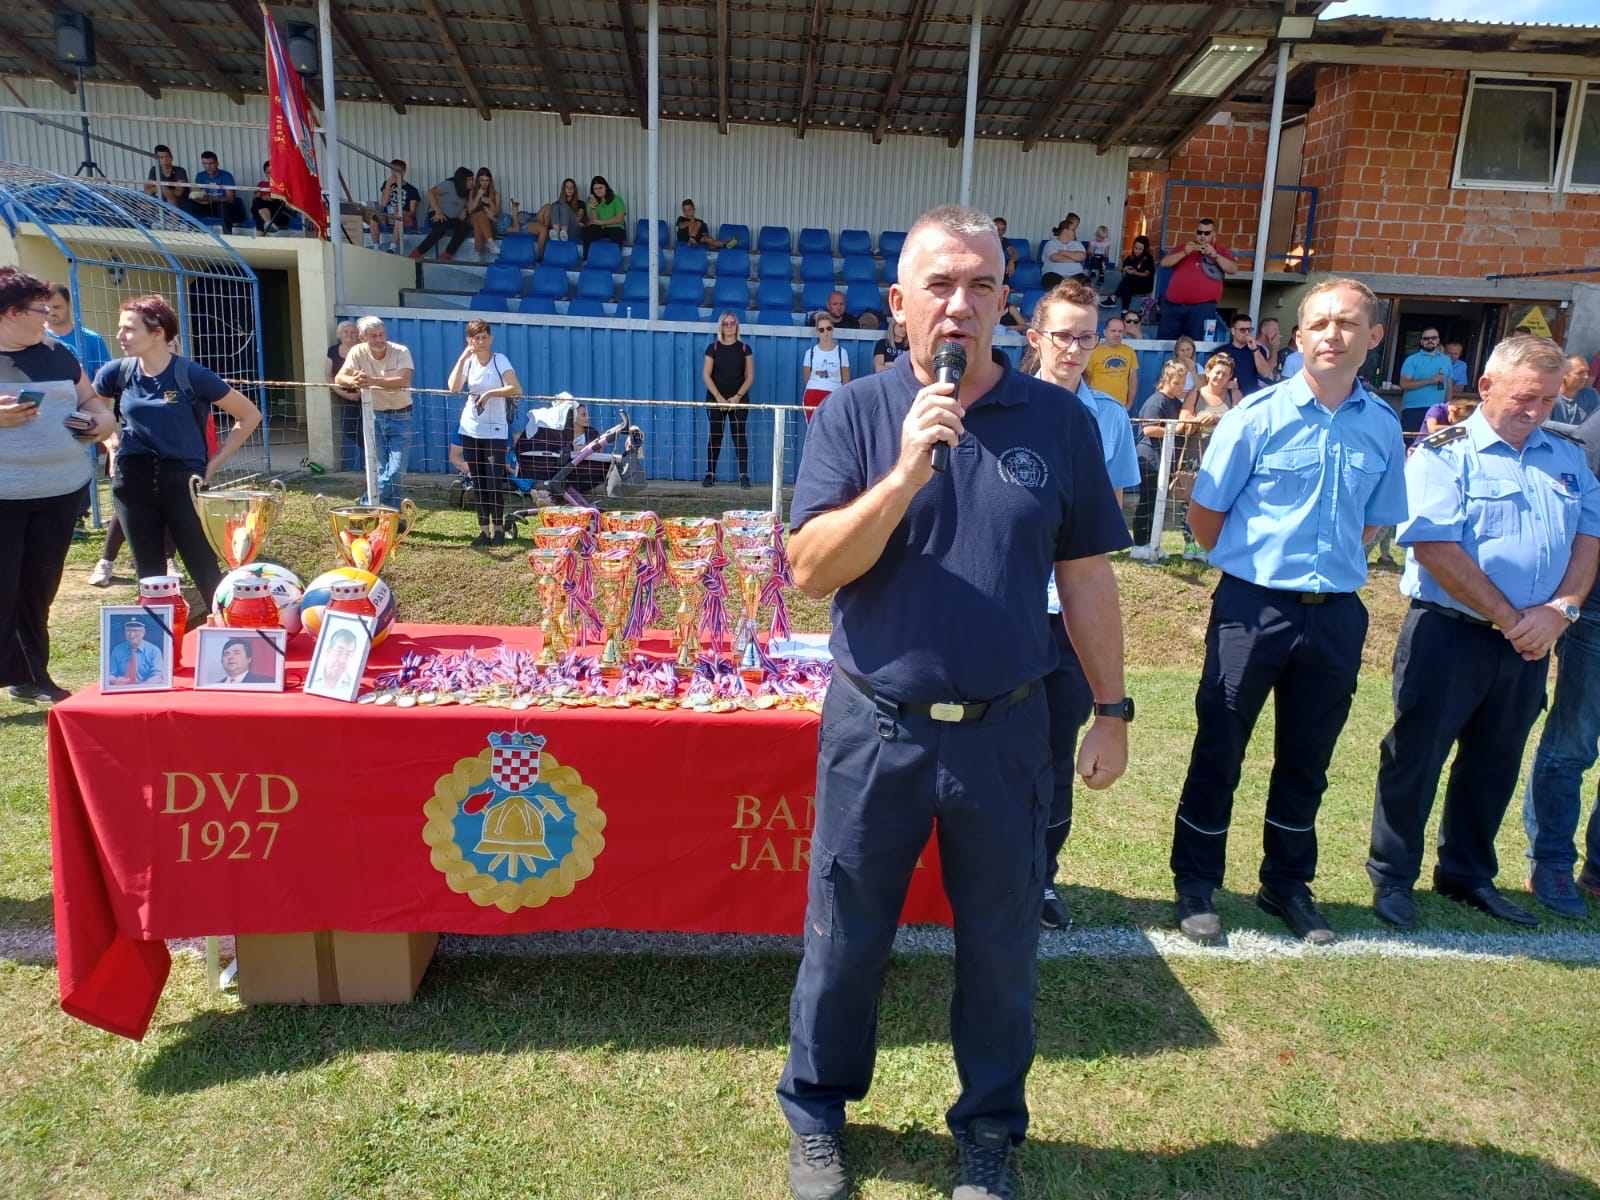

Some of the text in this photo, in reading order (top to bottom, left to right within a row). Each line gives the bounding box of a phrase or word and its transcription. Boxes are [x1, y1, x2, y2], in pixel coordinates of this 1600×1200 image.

[160, 771, 299, 814] DVD
[176, 820, 280, 863] 1927
[730, 835, 813, 872] JAR
